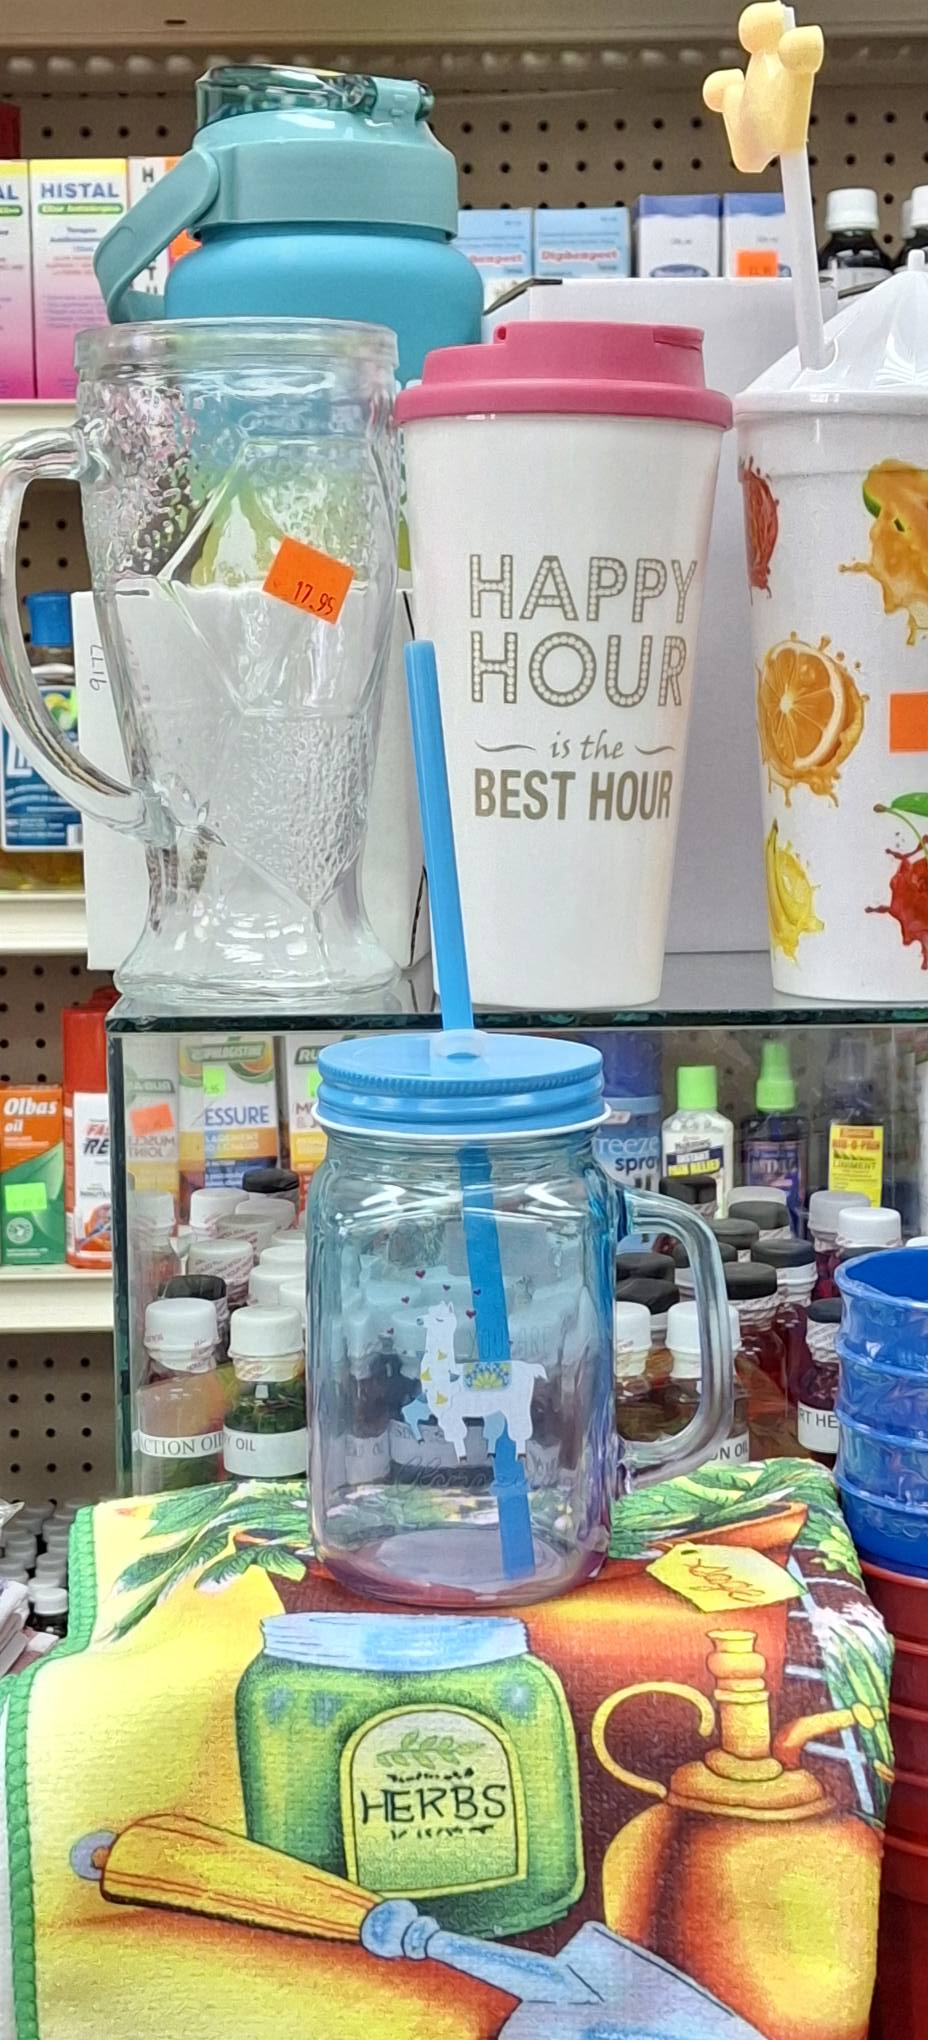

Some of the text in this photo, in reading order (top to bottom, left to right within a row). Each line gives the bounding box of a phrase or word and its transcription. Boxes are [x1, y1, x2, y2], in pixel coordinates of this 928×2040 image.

[41, 183, 119, 199] HISTAL
[294, 581, 336, 615] 17.95
[469, 553, 698, 624] HAPPY
[89, 645, 107, 691] 9177
[470, 630, 688, 709] HOUR
[551, 729, 624, 761] is the
[474, 768, 673, 821] BEST HOUR
[4, 1096, 58, 1116] Olbas
[205, 1106, 270, 1127] ESSURE
[4, 1119, 24, 1133] oil
[615, 1155, 658, 1176] spra
[236, 1439, 256, 1452] OIL
[360, 1785, 506, 1824] HERBS
